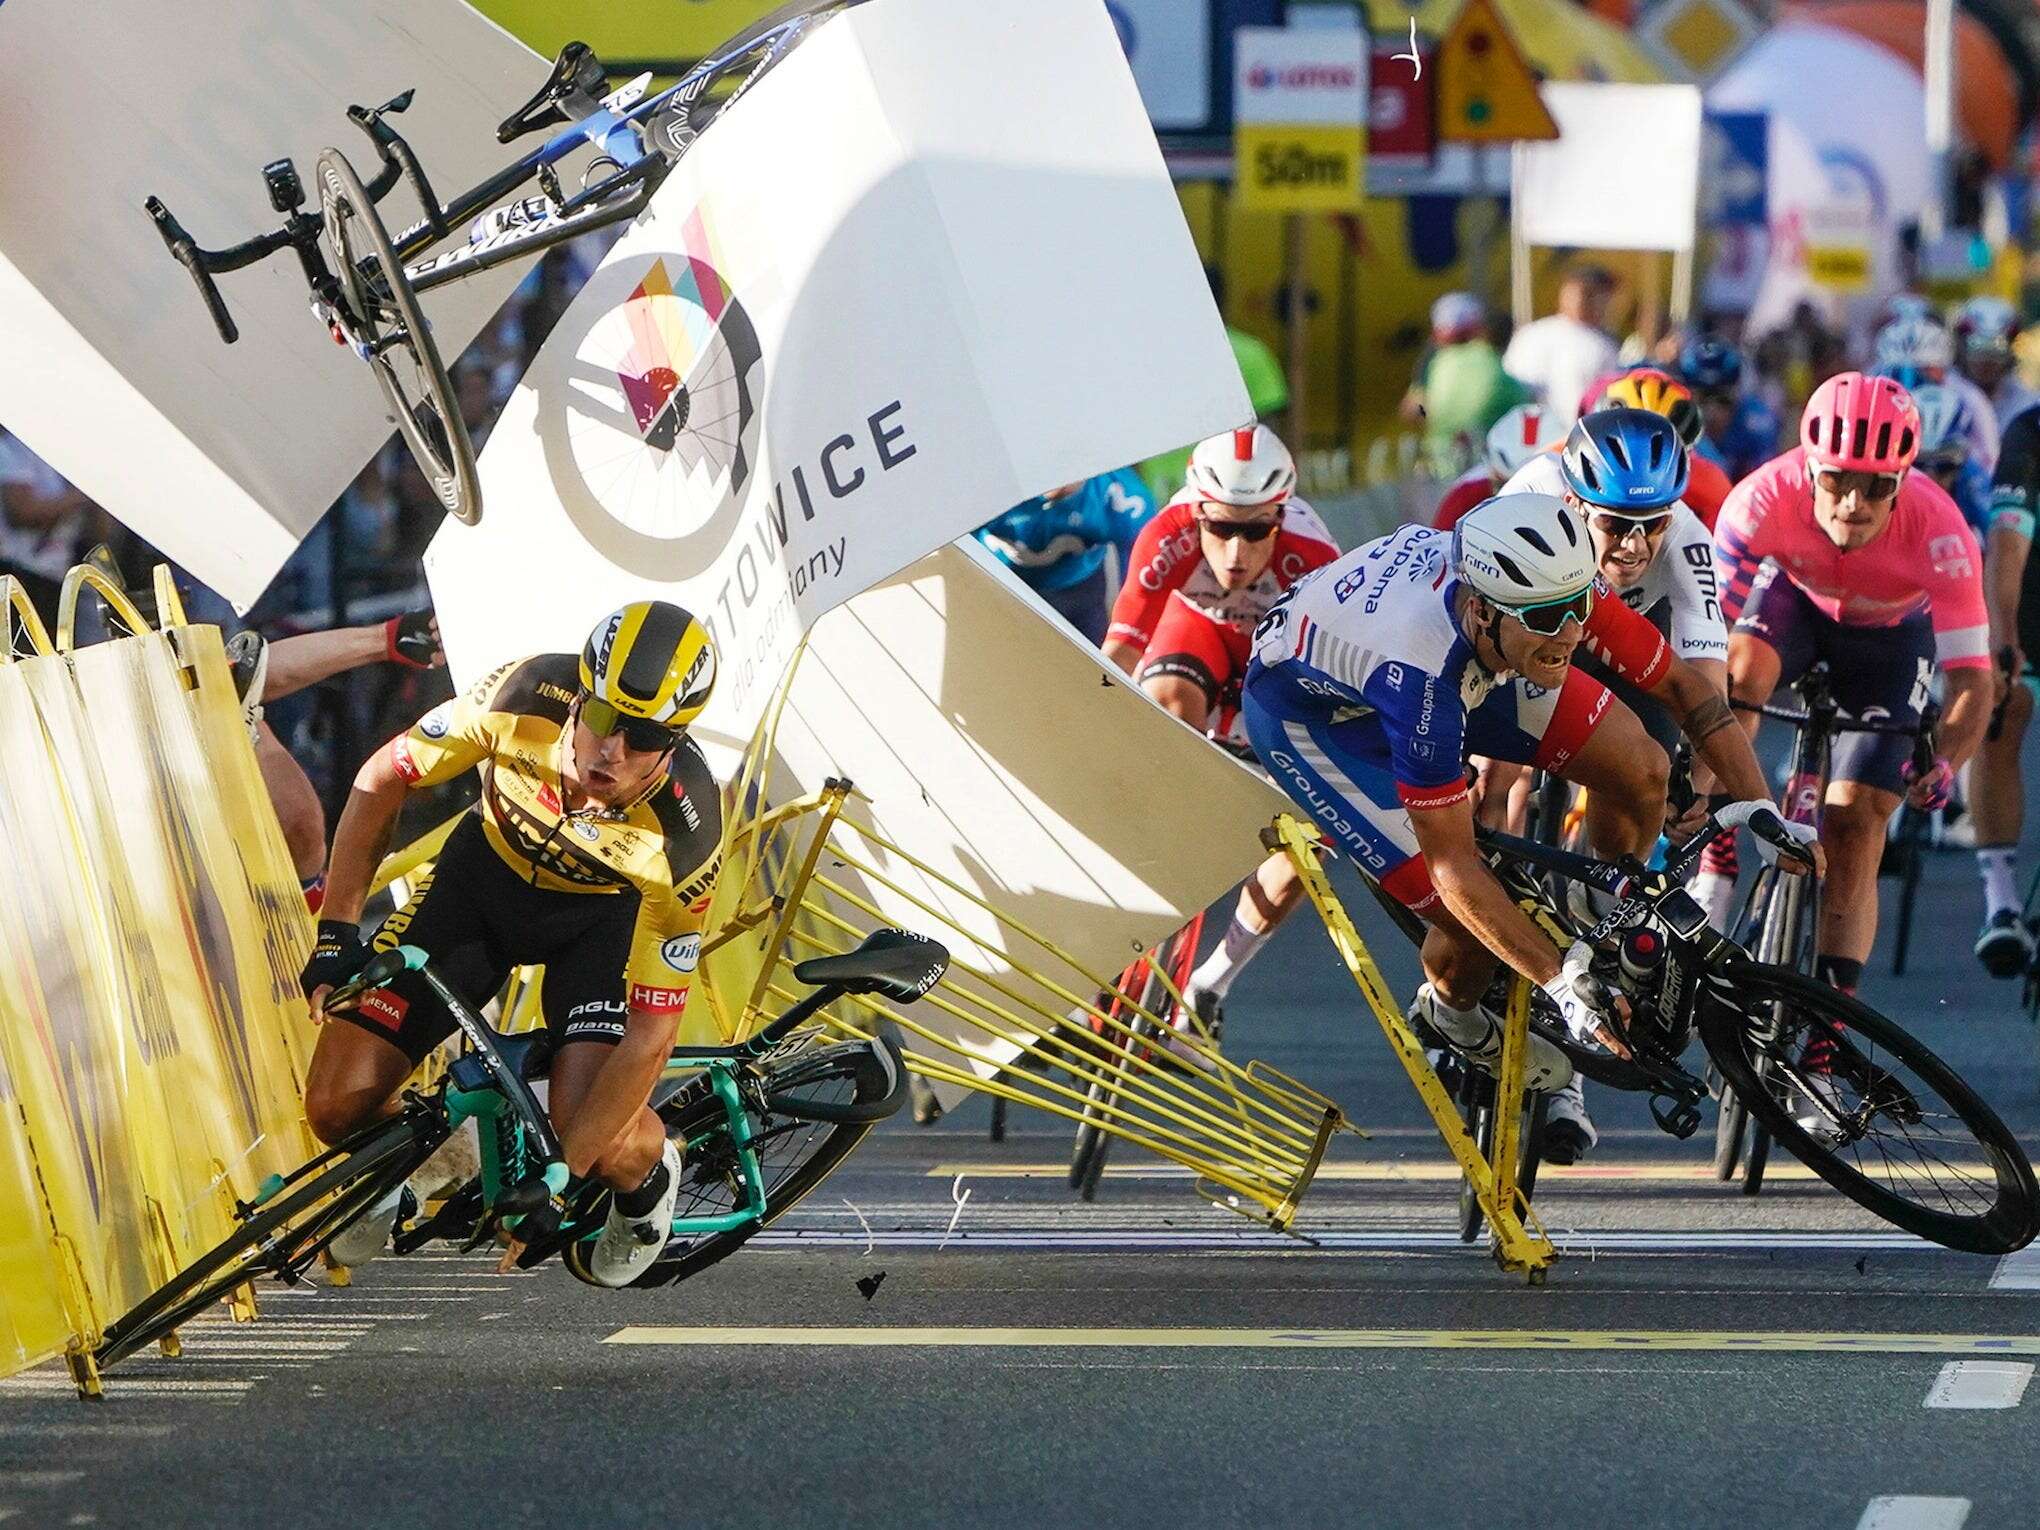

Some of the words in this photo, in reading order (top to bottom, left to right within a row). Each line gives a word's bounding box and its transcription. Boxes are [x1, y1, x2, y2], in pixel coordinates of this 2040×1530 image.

[704, 399, 917, 663] ATOWICE
[1138, 526, 1200, 592] Cofid
[1364, 528, 1441, 614] roupama
[1682, 542, 1725, 625] BMC
[1415, 673, 1436, 736] Groupama
[679, 795, 702, 833] VISMA
[1269, 750, 1387, 869] Groupama
[676, 854, 722, 908] JUM
[635, 987, 687, 1008] HEM
